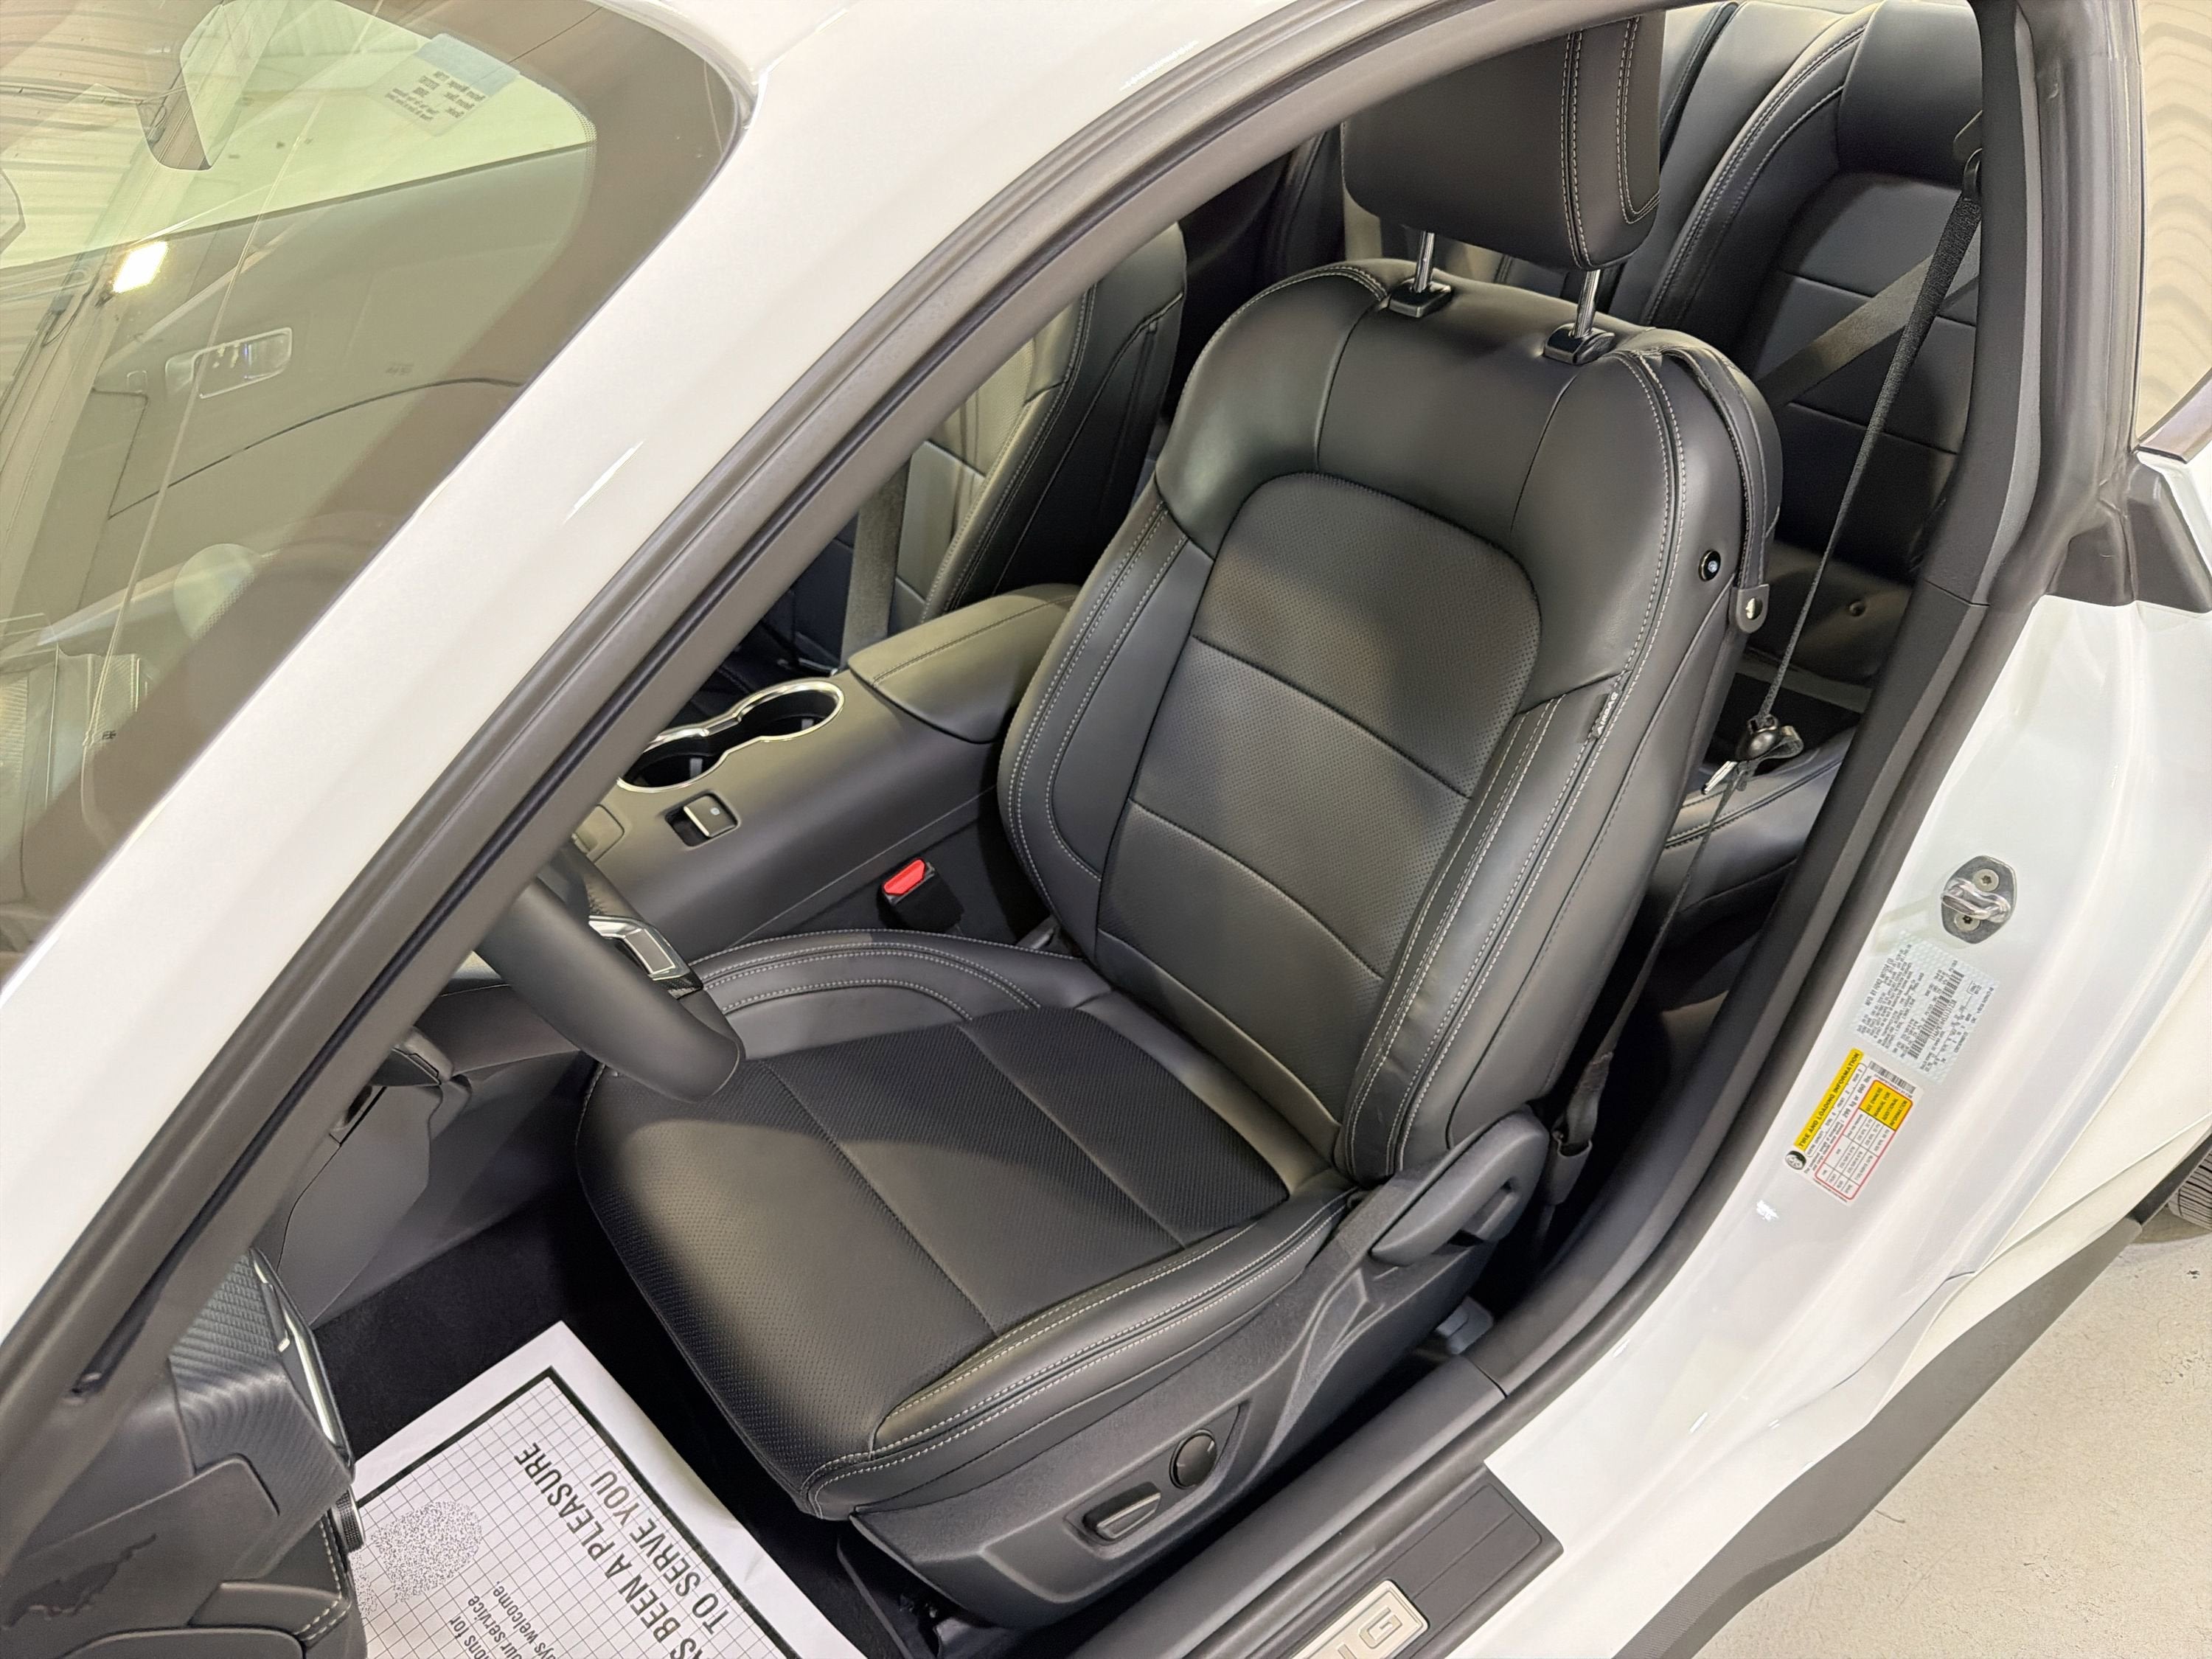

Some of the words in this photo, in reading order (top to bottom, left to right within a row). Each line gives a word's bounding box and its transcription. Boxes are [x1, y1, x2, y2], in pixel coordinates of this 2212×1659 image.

[1595, 691, 1618, 736] AIRBAG
[1798, 1133, 1810, 1147] TIRE
[1807, 1119, 1818, 1133] AND
[1815, 1093, 1834, 1120] LOADING
[1832, 1051, 1860, 1093] INFORMATION
[515, 1443, 616, 1560] PLEASURE
[591, 1471, 637, 1526] YOU
[605, 1554, 632, 1578] A
[630, 1521, 700, 1596] SERVE
[449, 1615, 470, 1639] for
[468, 1596, 506, 1642] service
[493, 1581, 538, 1644] welcome.
[619, 1574, 681, 1643] BEEN
[692, 1593, 728, 1635] TO
[465, 1635, 490, 1659] ons
[670, 1638, 706, 1659] S
